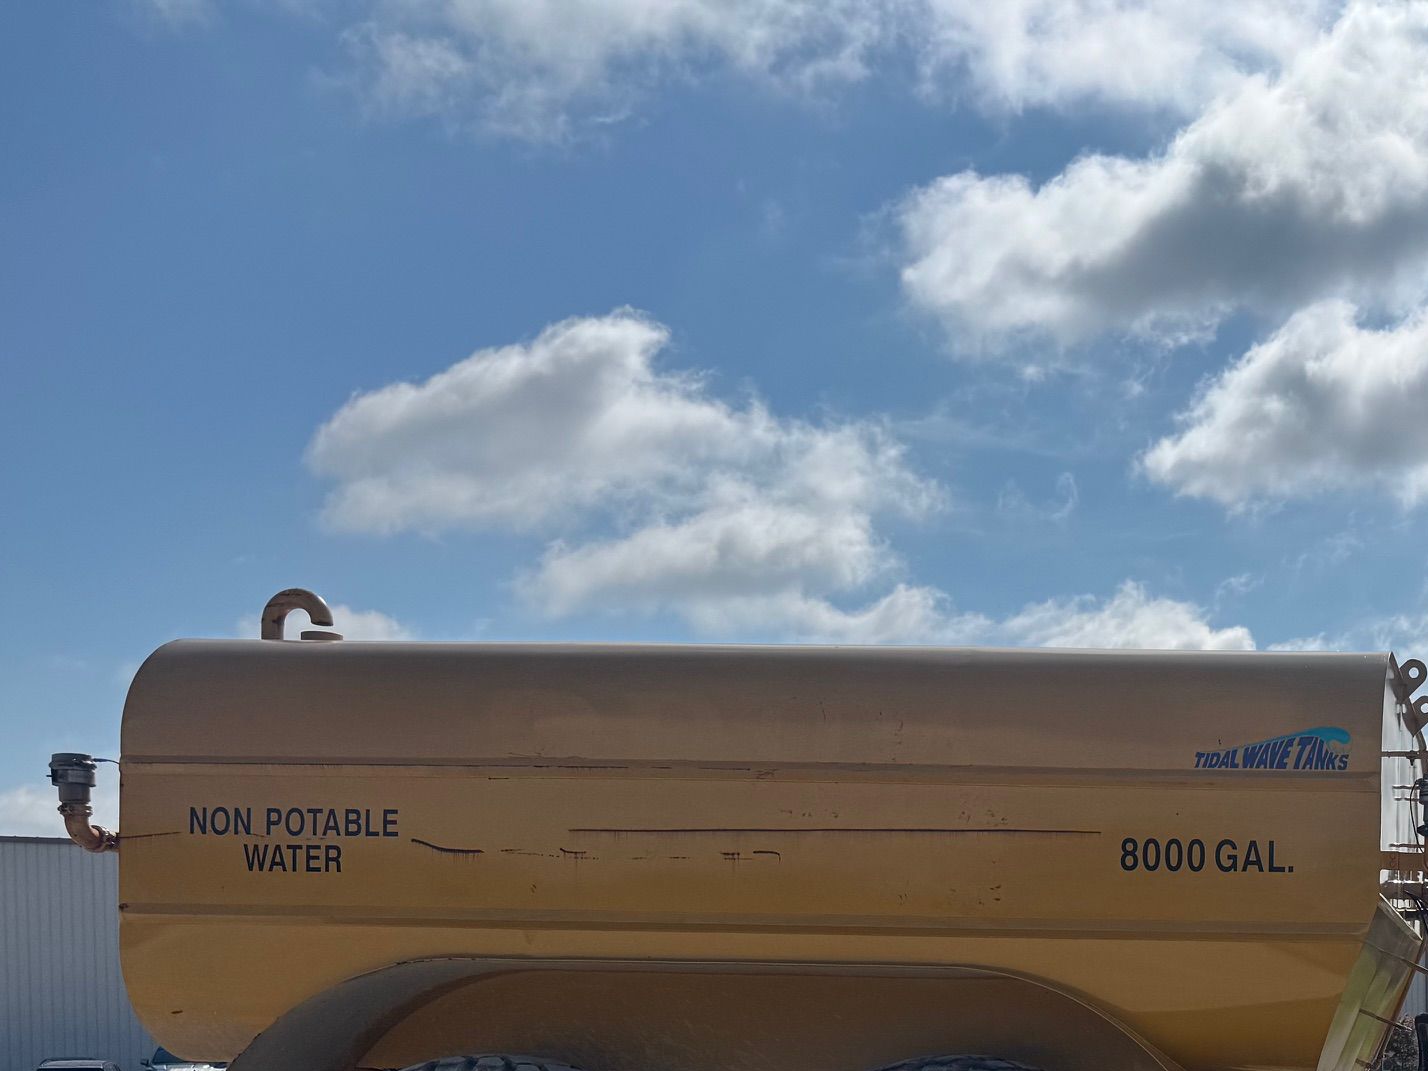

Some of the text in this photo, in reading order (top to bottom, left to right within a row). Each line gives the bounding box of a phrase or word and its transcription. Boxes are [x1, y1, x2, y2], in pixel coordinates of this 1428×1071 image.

[1194, 736, 1349, 770] TIDAL WAVE TANKS
[189, 806, 399, 837] NON POTABLE
[243, 843, 342, 873] WATER
[1120, 837, 1294, 873] 8000 GAL.
